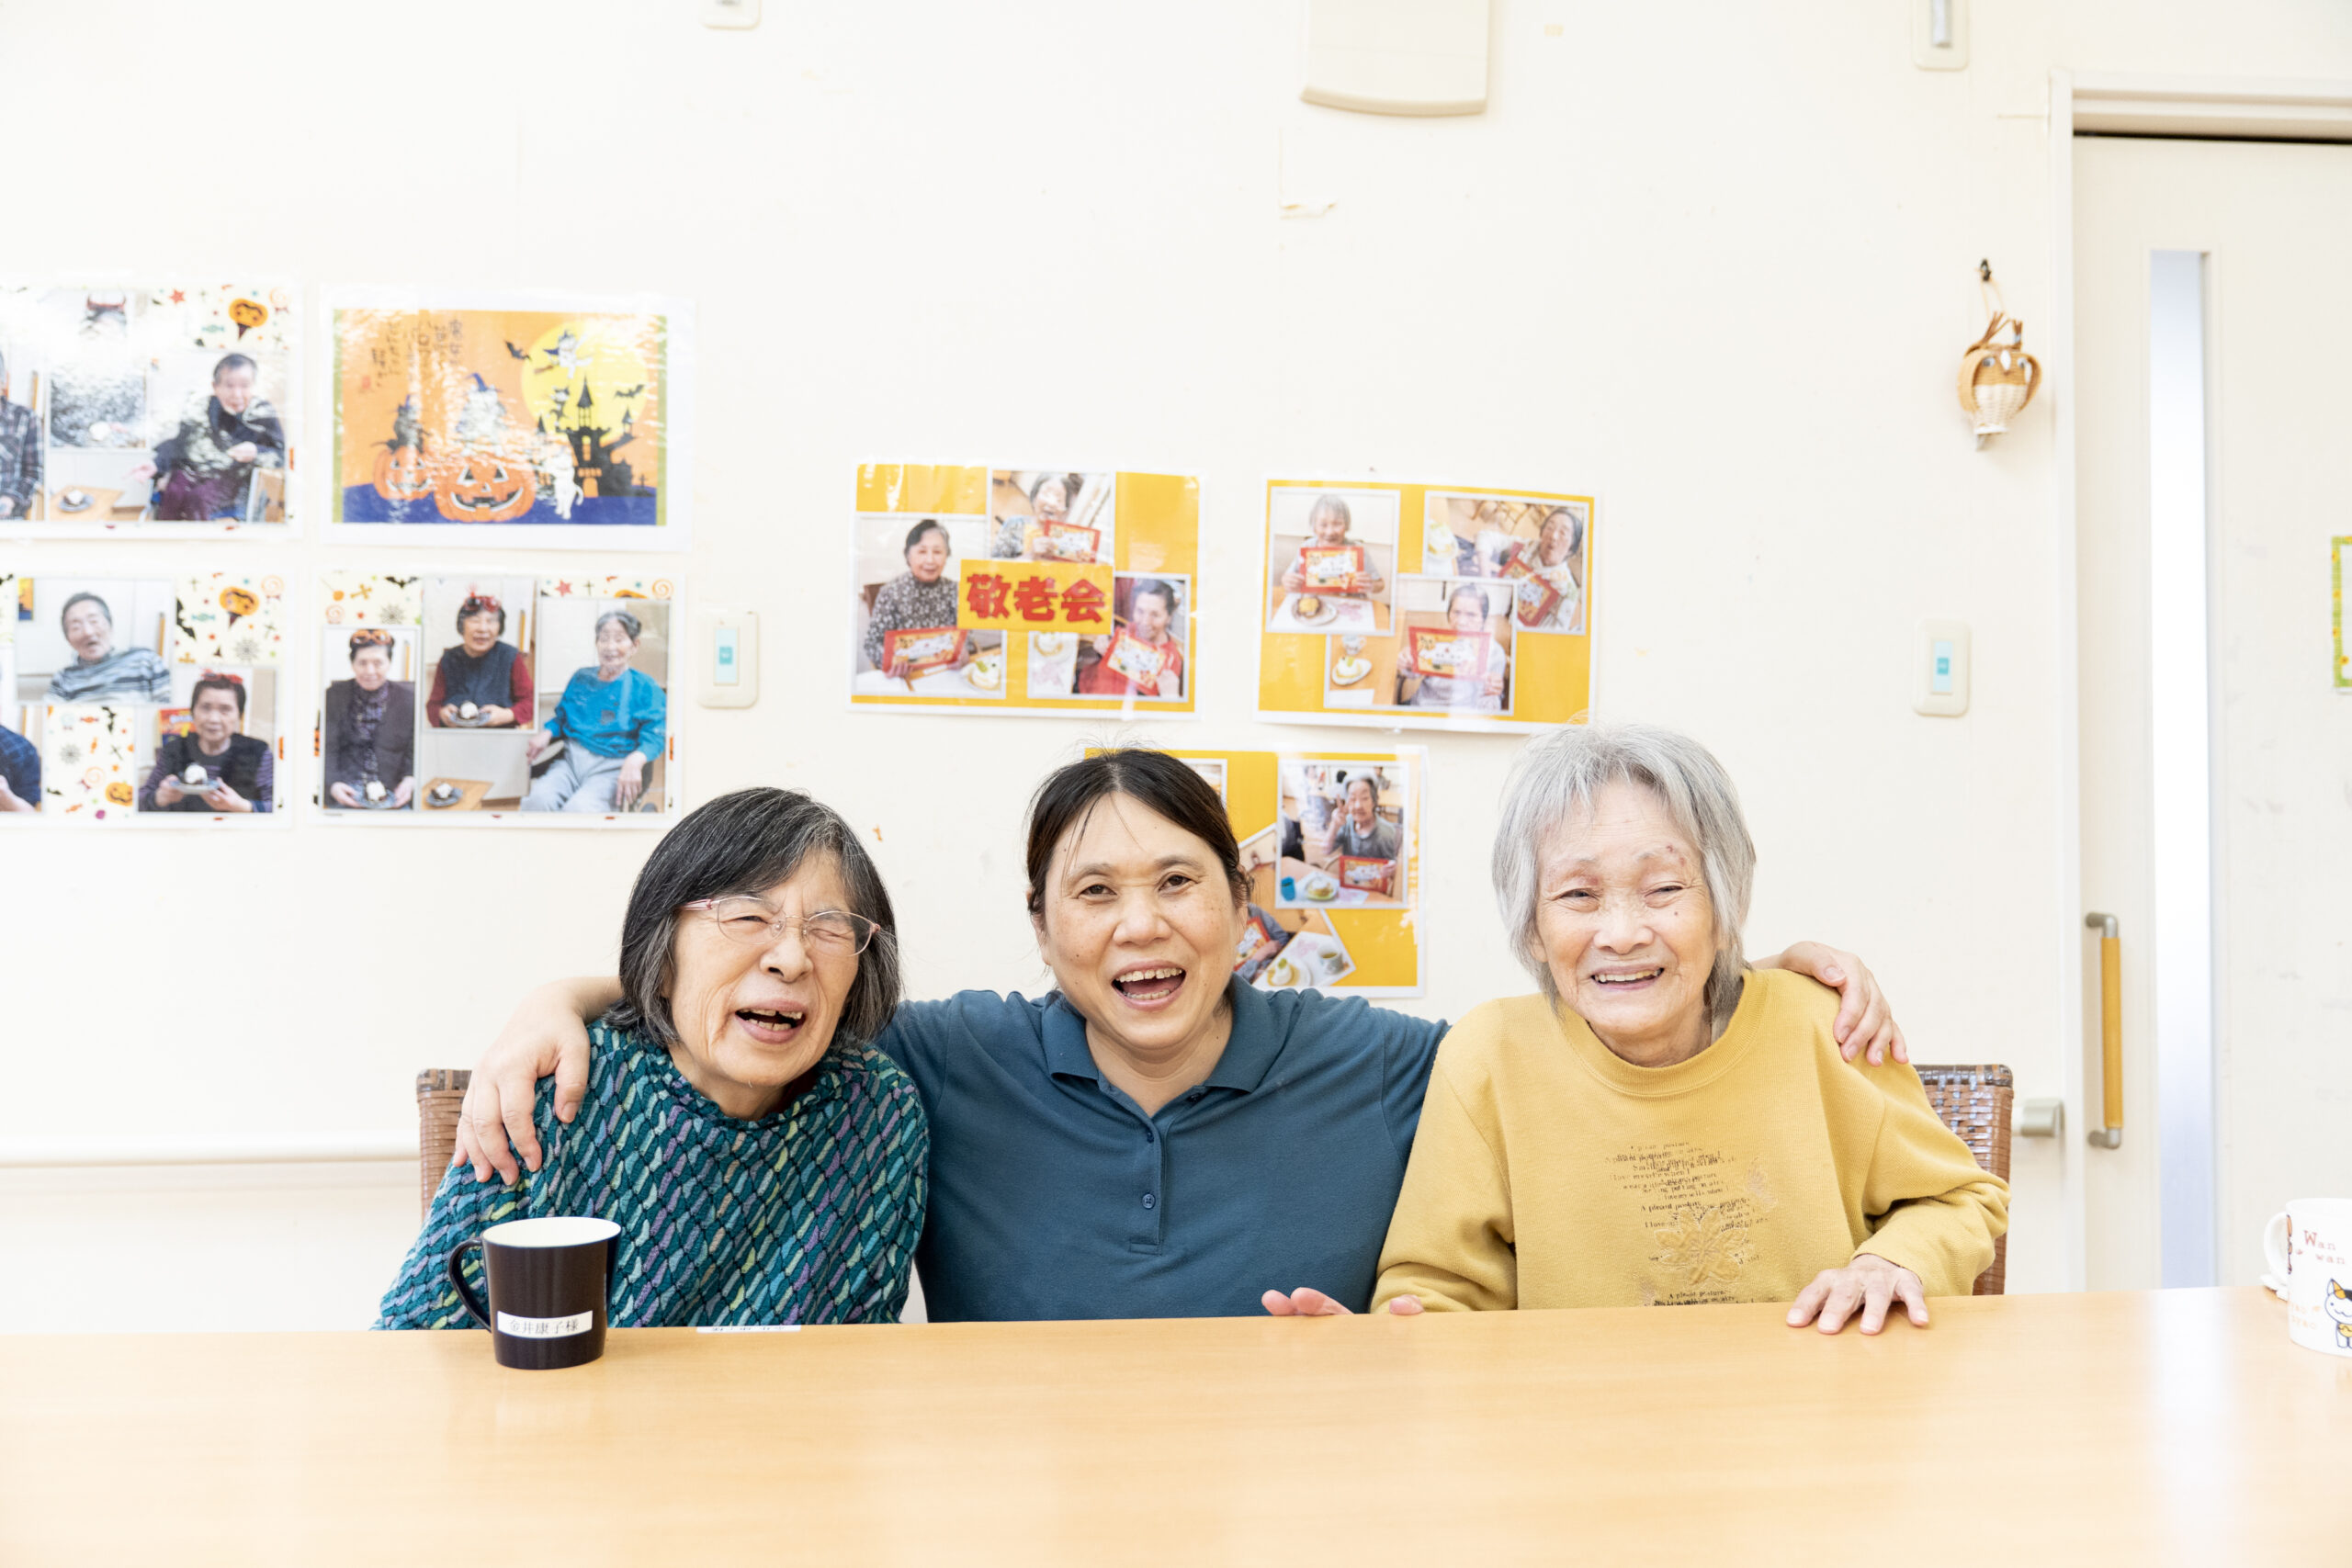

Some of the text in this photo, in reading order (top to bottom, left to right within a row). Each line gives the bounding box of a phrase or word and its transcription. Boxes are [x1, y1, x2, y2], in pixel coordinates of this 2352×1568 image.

[967, 573, 1104, 623] 敬老会
[2303, 1230, 2336, 1251] Wan
[2315, 1254, 2346, 1265] wan
